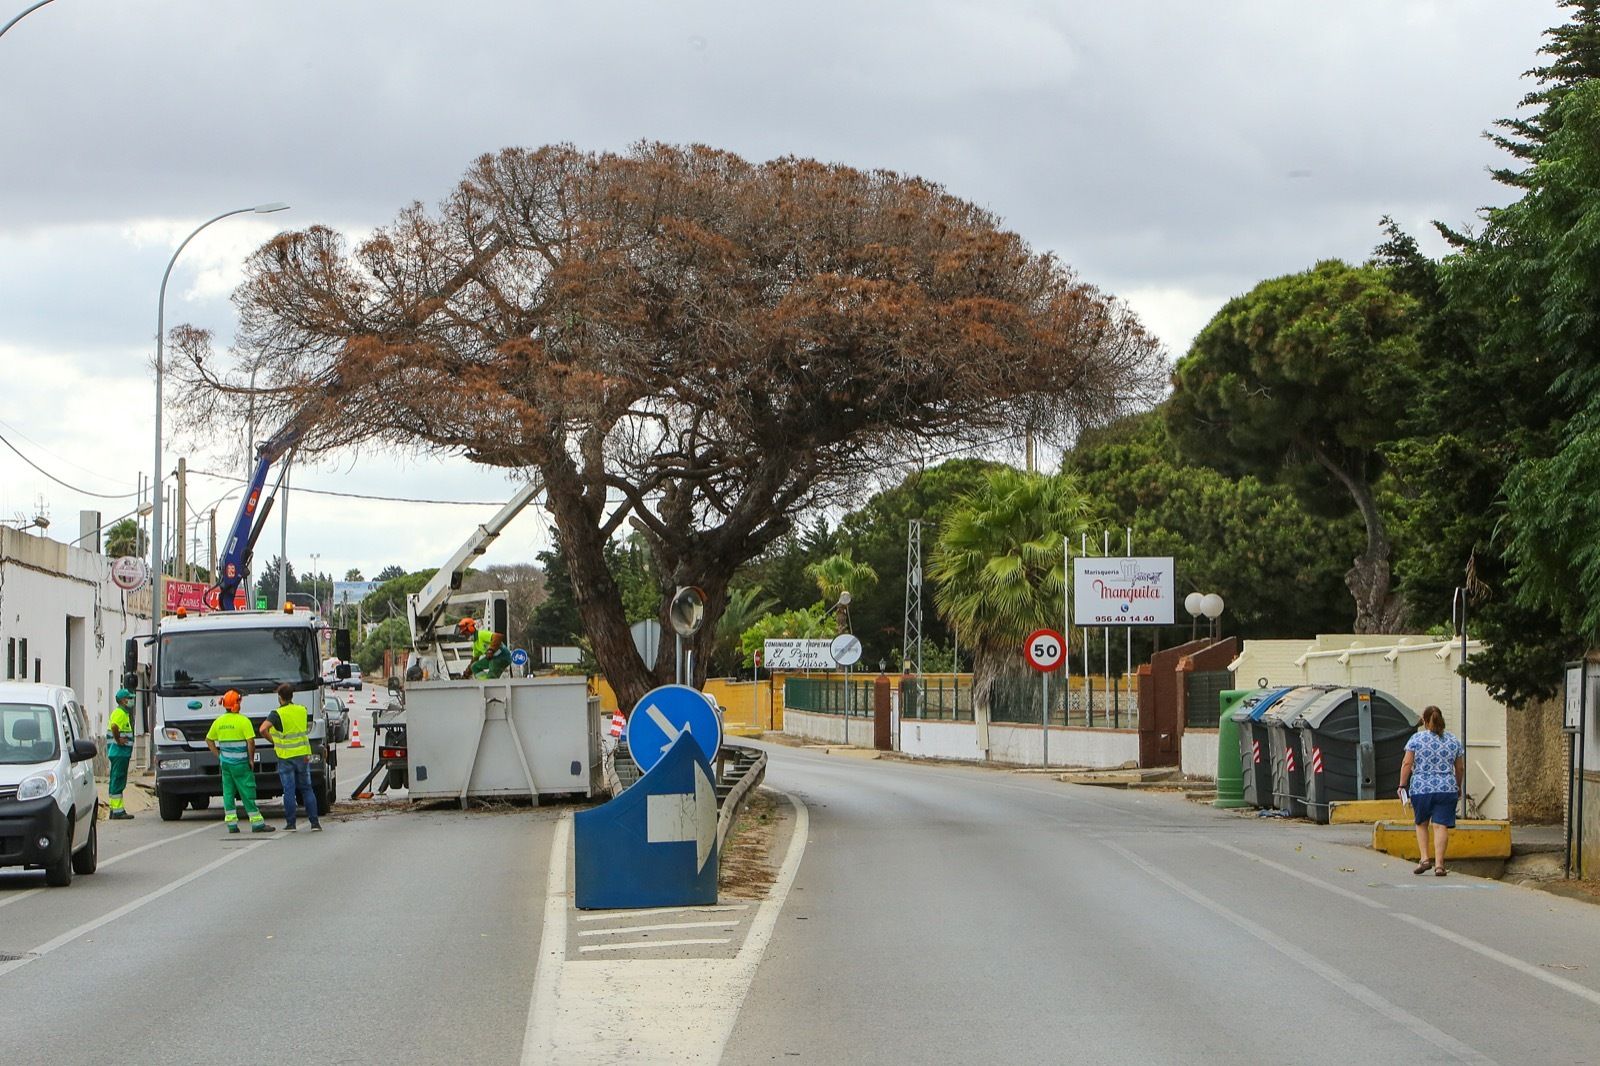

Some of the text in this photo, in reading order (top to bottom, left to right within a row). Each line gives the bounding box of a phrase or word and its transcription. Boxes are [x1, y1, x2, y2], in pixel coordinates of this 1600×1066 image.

[177, 583, 193, 594] VENTA
[1092, 579, 1161, 603] Manguita
[773, 648, 818, 659] El Pinar
[1034, 644, 1057, 658] 50
[766, 659, 775, 667] de
[779, 657, 791, 667] los
